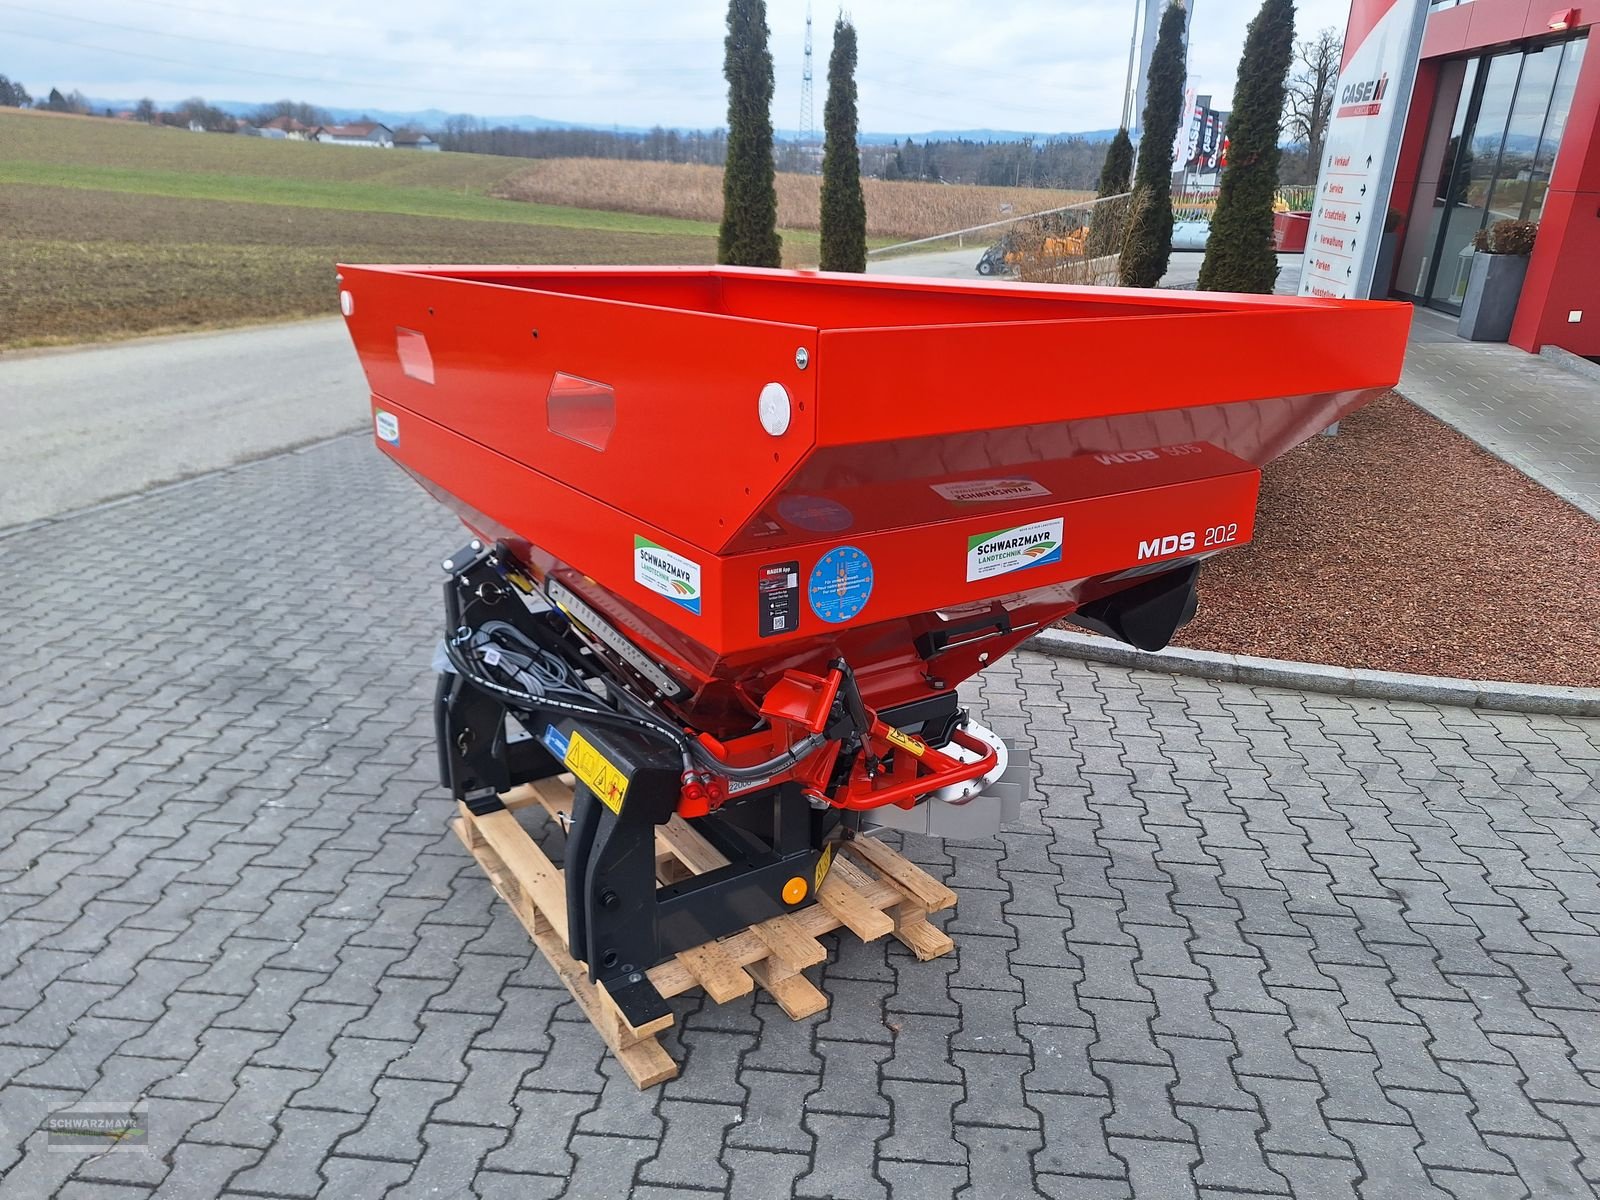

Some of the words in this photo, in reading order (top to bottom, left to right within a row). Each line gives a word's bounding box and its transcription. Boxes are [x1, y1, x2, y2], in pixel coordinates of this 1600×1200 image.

[1342, 81, 1374, 104] CASE
[1187, 121, 1200, 160] CASE
[1334, 156, 1350, 166] Verkauf
[1329, 183, 1344, 194] Service
[1324, 209, 1346, 221] Ersatzteile
[1321, 235, 1344, 249] Verwaltung
[1315, 259, 1330, 271] Parken
[977, 531, 1051, 555] SCHWARZMAYR
[1138, 532, 1196, 560] MDS
[1204, 523, 1237, 546] 20.2
[978, 549, 1022, 564] LANDTECHNIK
[640, 549, 691, 582] SCHWARZMAYR
[641, 562, 670, 581] LANDTECHNIK
